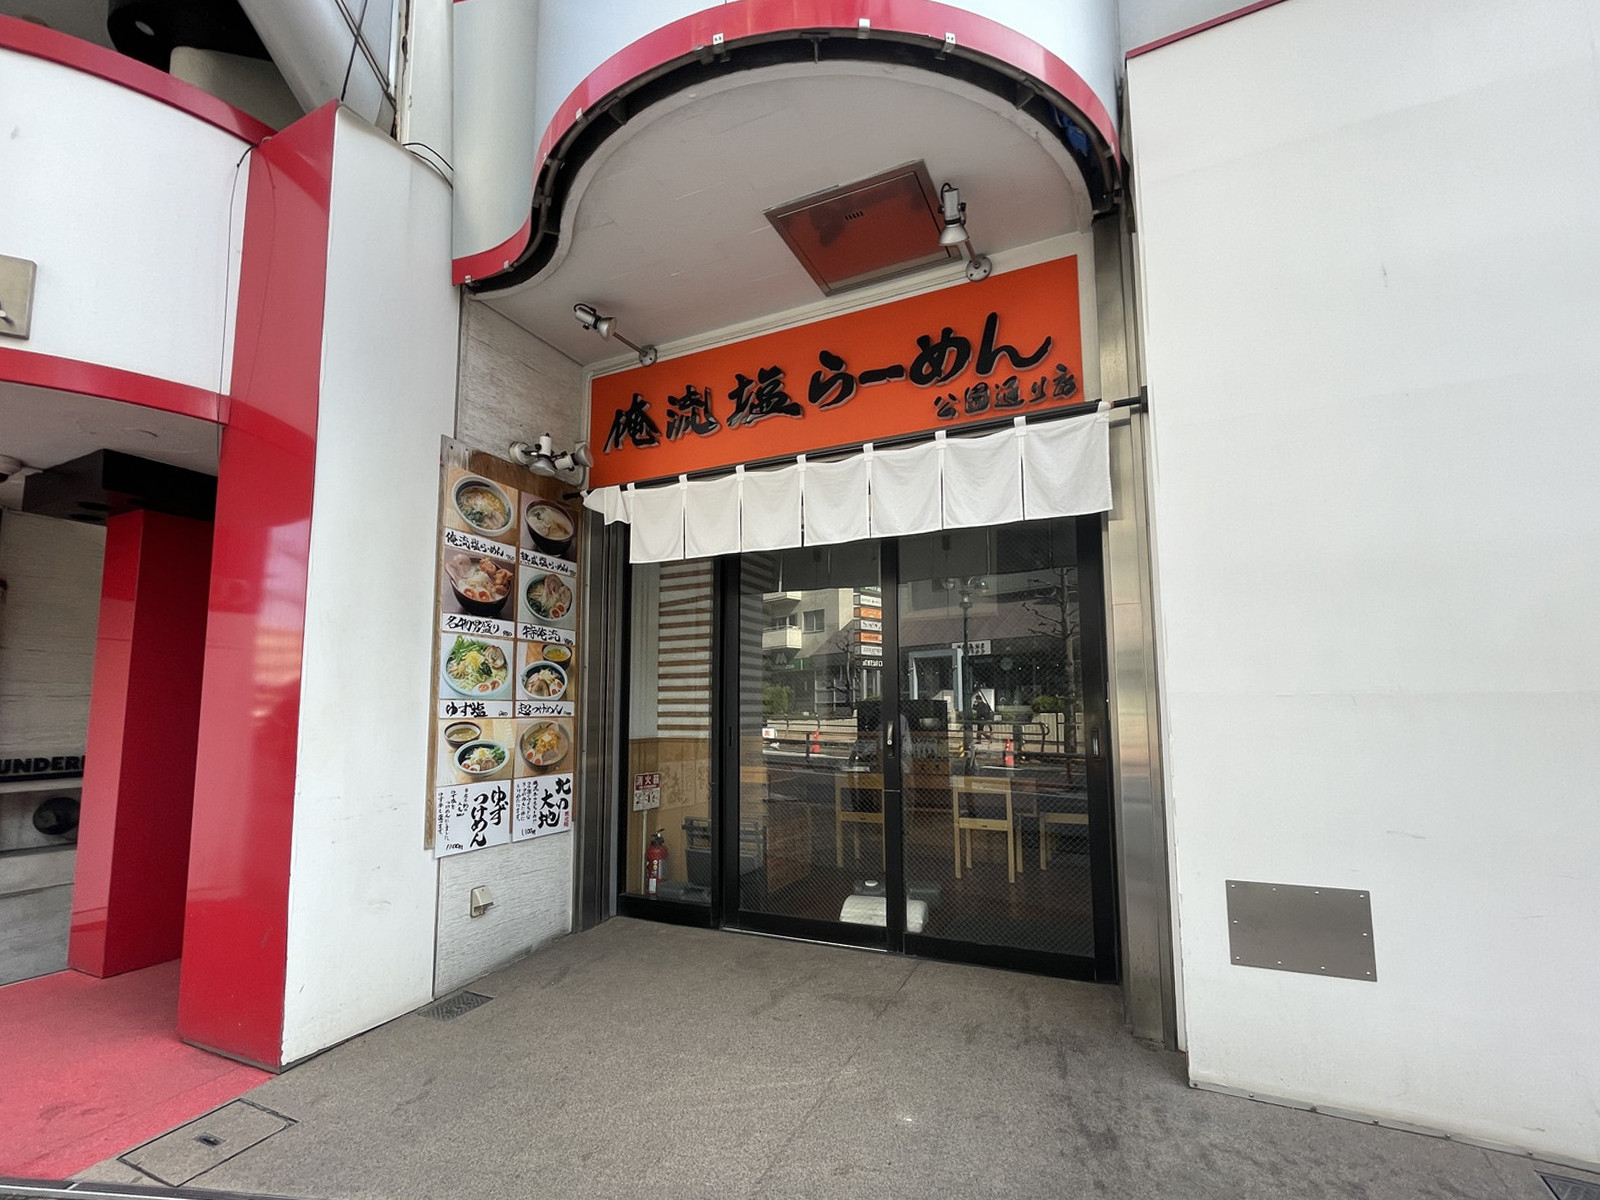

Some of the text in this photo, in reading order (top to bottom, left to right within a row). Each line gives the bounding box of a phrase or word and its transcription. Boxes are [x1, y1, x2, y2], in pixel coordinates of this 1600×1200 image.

[602, 311, 1053, 454] 俺流塩らーめん
[933, 363, 1077, 420] 公園通り店
[445, 702, 489, 718] ゆず塩
[0, 755, 85, 775] UNDER
[469, 793, 489, 848] つけめん
[489, 785, 509, 826] ゆず
[537, 788, 561, 829] 大地
